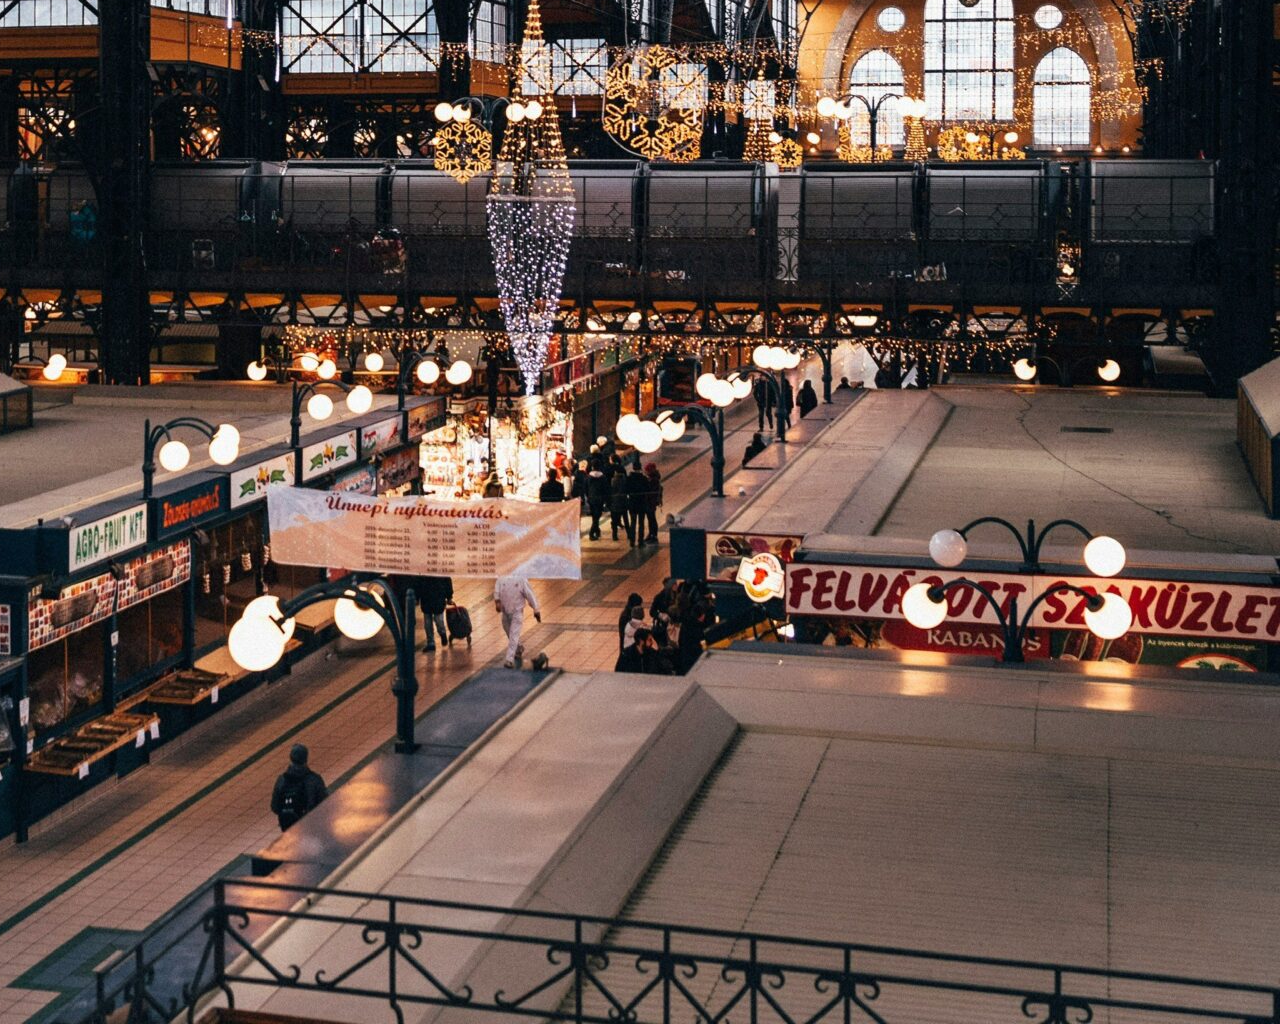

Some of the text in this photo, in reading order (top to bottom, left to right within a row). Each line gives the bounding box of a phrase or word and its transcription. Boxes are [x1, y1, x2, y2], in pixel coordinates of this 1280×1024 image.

[325, 492, 509, 520] Ünnepi nyitvatartás.
[75, 510, 146, 564] AGRO-FRUIT KFT.
[789, 568, 1027, 619] FELVÁOTT
[1043, 580, 1280, 636] SZKÜZLET
[927, 629, 1041, 652] KABANS
